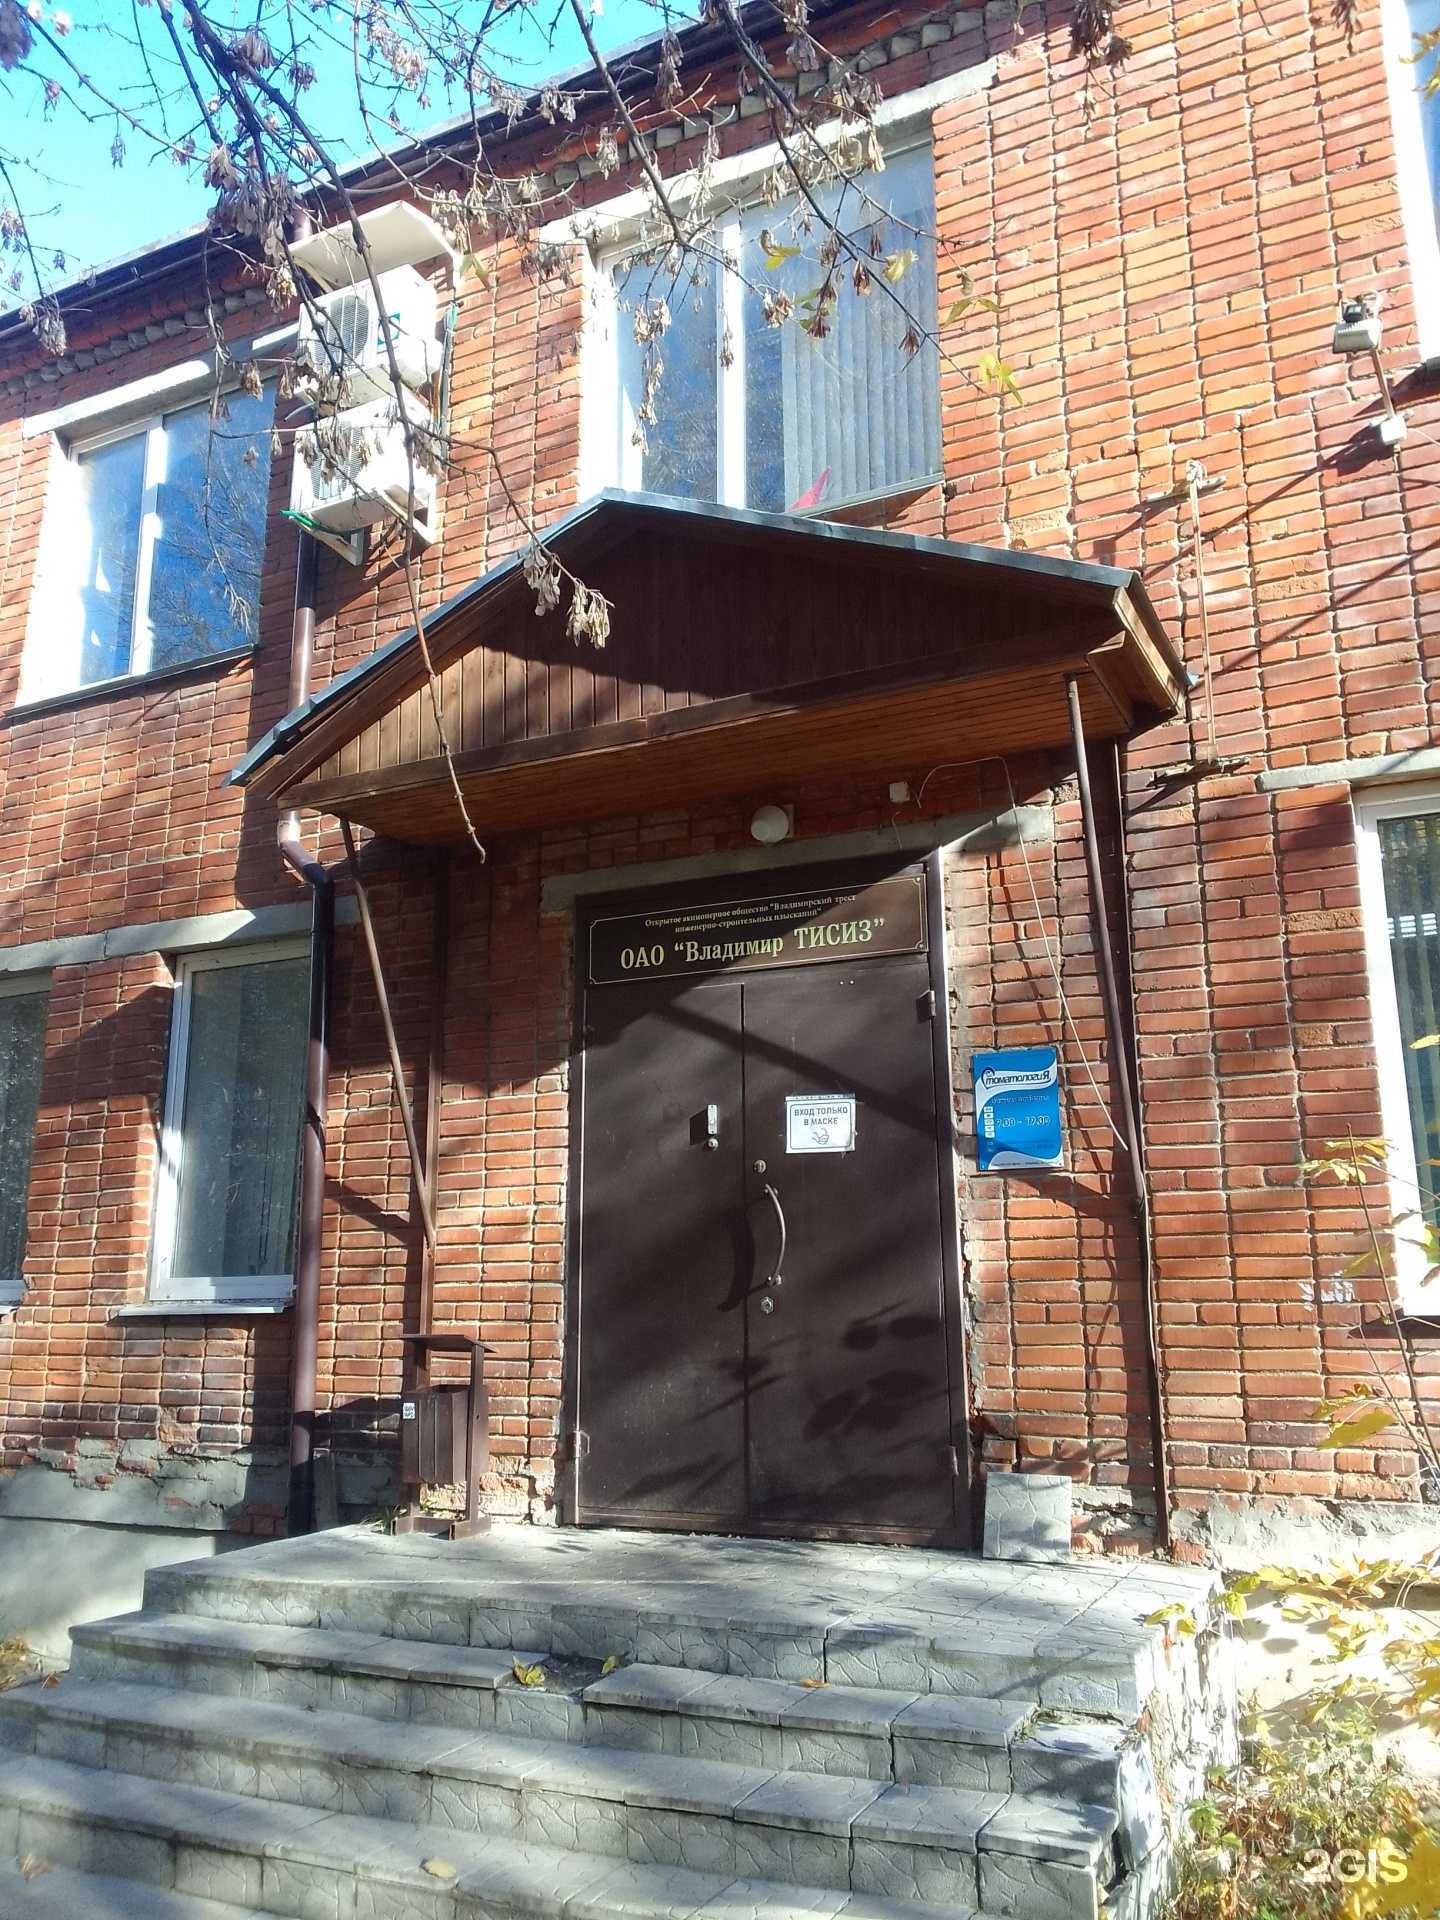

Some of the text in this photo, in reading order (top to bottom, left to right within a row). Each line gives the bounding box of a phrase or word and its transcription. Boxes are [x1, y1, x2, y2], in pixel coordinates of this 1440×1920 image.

[645, 917, 681, 928] Открытое
[682, 910, 730, 922] акционерное
[731, 906, 769, 916] общество
[835, 895, 857, 905] трест
[675, 915, 773, 933] инженерно-строительных
[620, 945, 665, 970] ОАО
[674, 938, 784, 962] “Владимир
[794, 1106, 848, 1117] ВХОД ТОЛЬКО
[803, 1117, 839, 1126] В МАСКЕ
